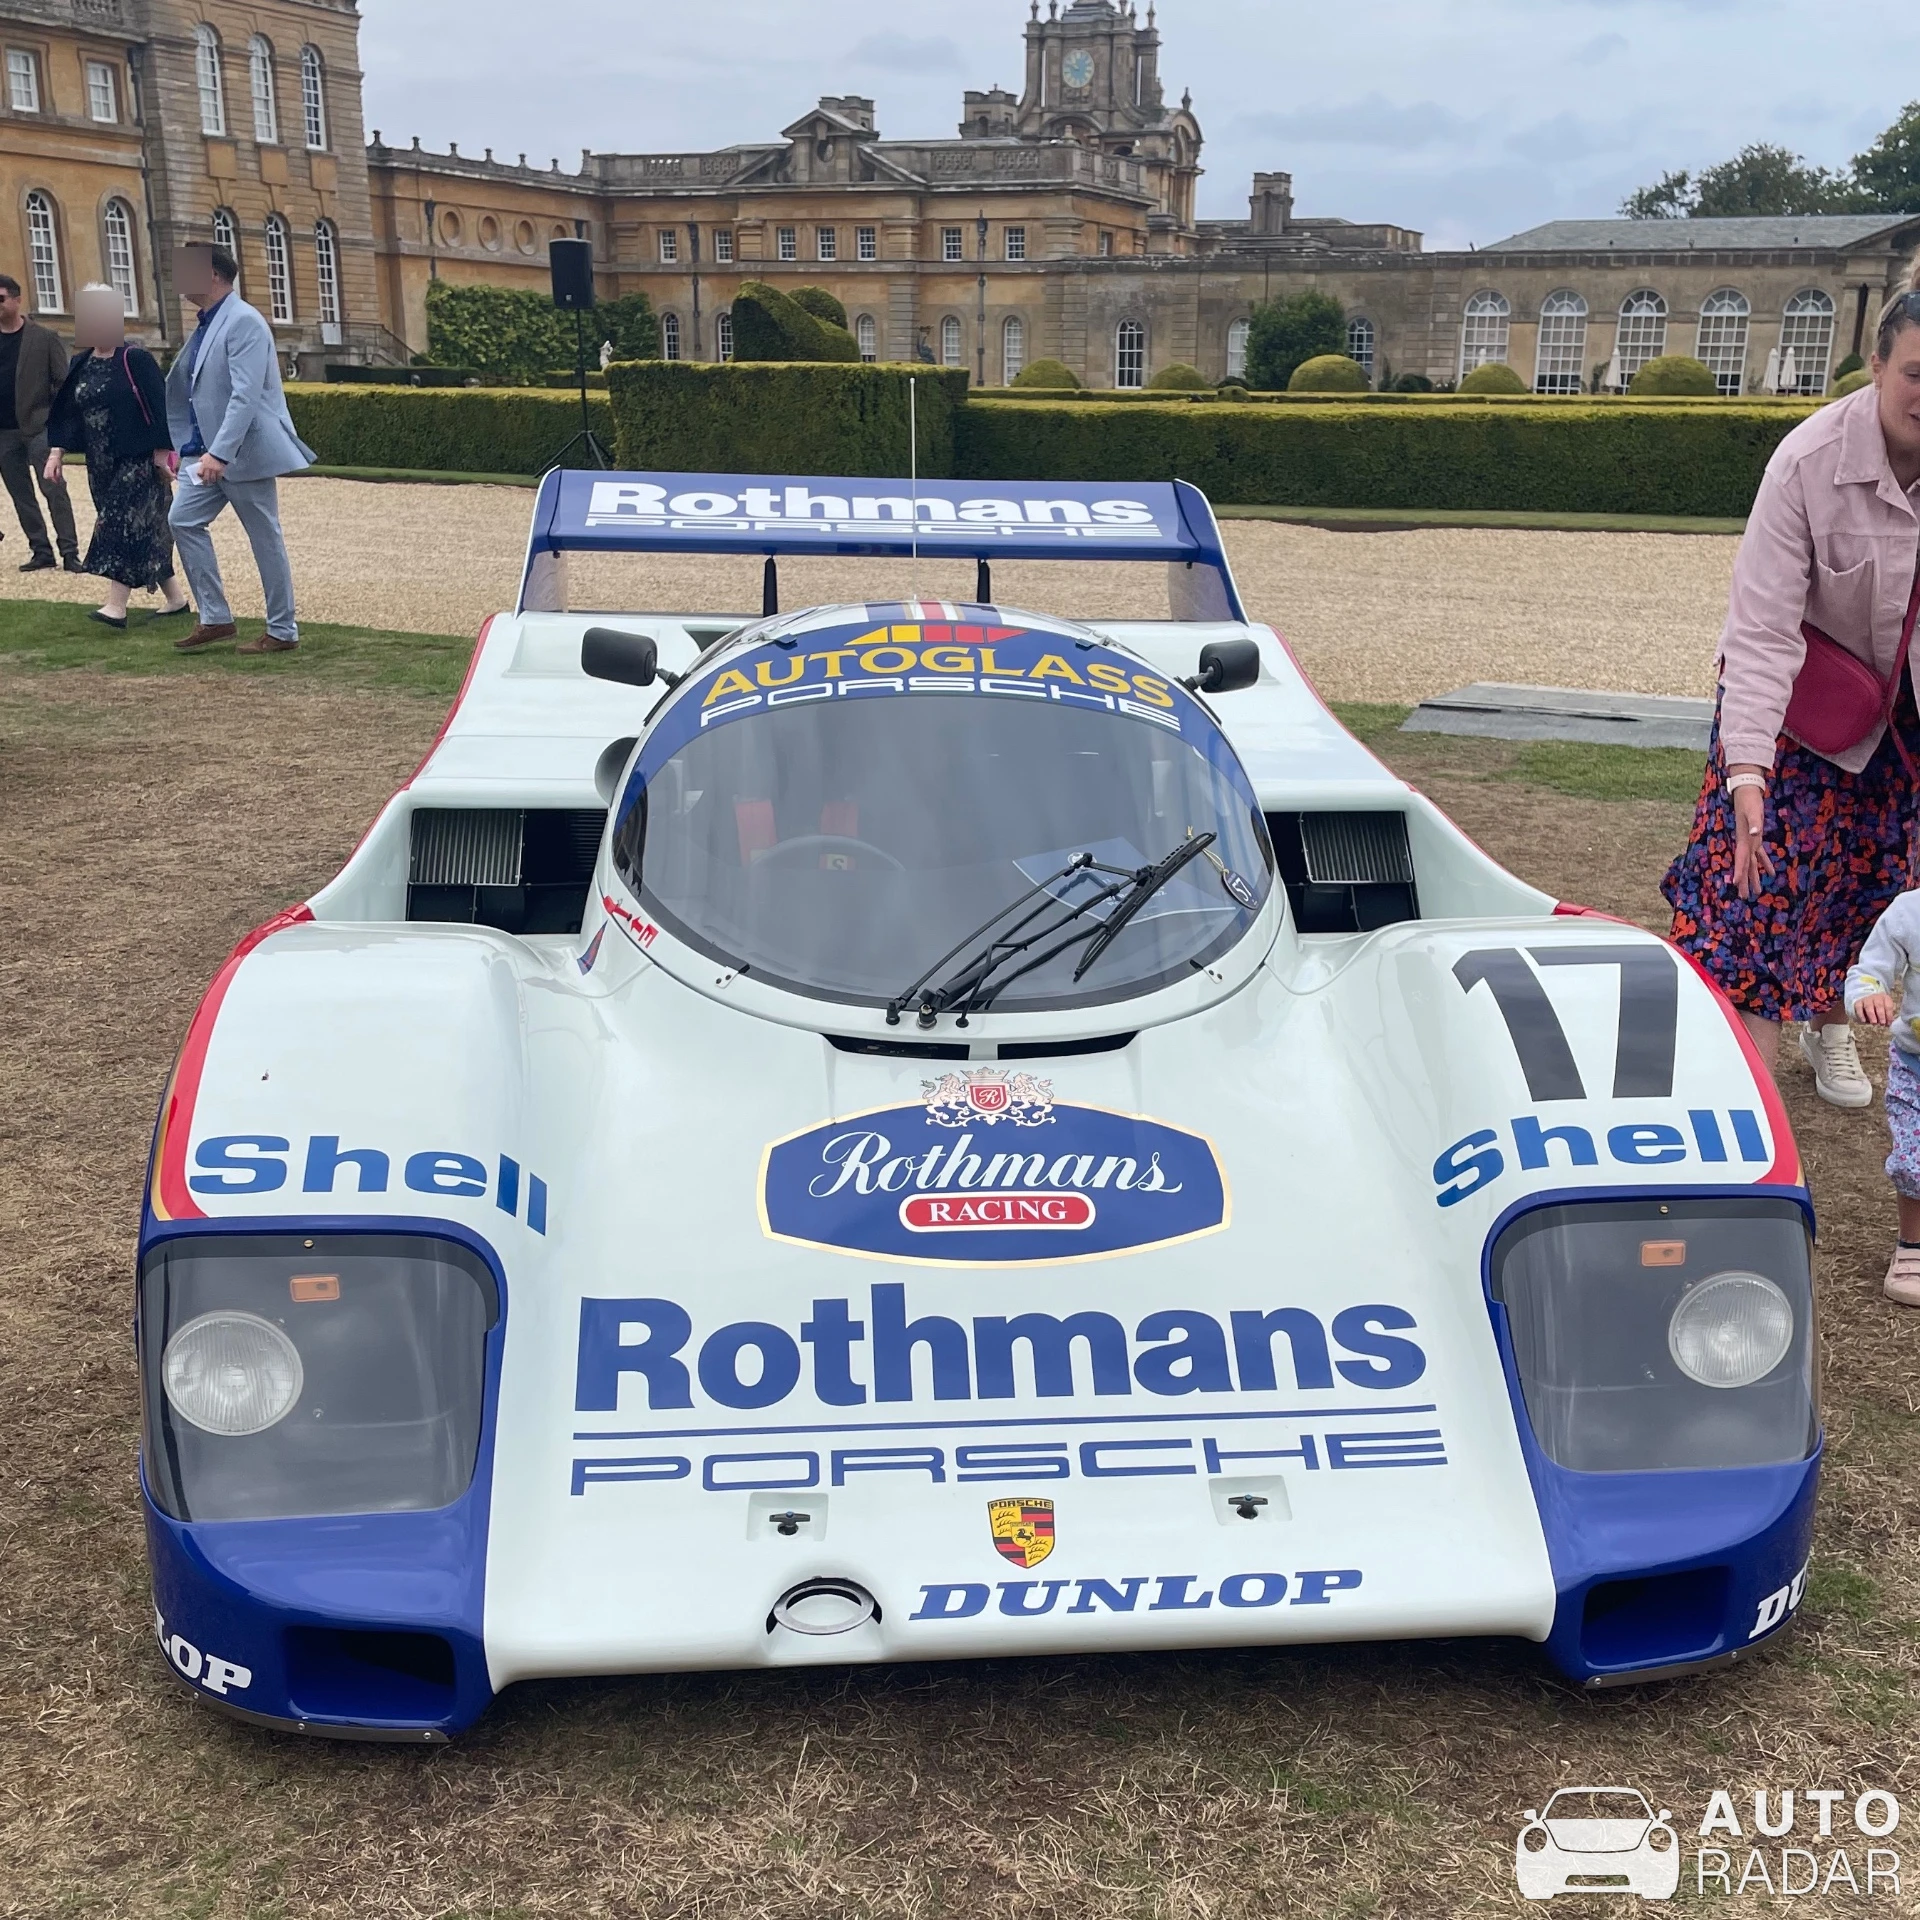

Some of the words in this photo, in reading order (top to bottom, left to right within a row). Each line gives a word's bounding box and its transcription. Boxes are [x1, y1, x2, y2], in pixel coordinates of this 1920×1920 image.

[585, 518, 1163, 537] PORSCHE
[587, 481, 1154, 524] Rothmans
[700, 645, 1175, 709] AUTOGLASS
[700, 677, 1182, 732] PORSCHE
[1231, 876, 1252, 902] 57
[1452, 944, 1679, 1102] 17
[978, 1088, 1000, 1105] R
[188, 1135, 548, 1237] Shell
[808, 1130, 1183, 1198] Rothmans
[1432, 1109, 1769, 1208] Shell
[927, 1198, 1068, 1225] RACING
[574, 1283, 1428, 1412] Rothmans
[570, 1429, 1449, 1497] PORSCHE
[989, 1499, 1053, 1510] PORSCHE
[908, 1568, 1363, 1621] DUNLOP
